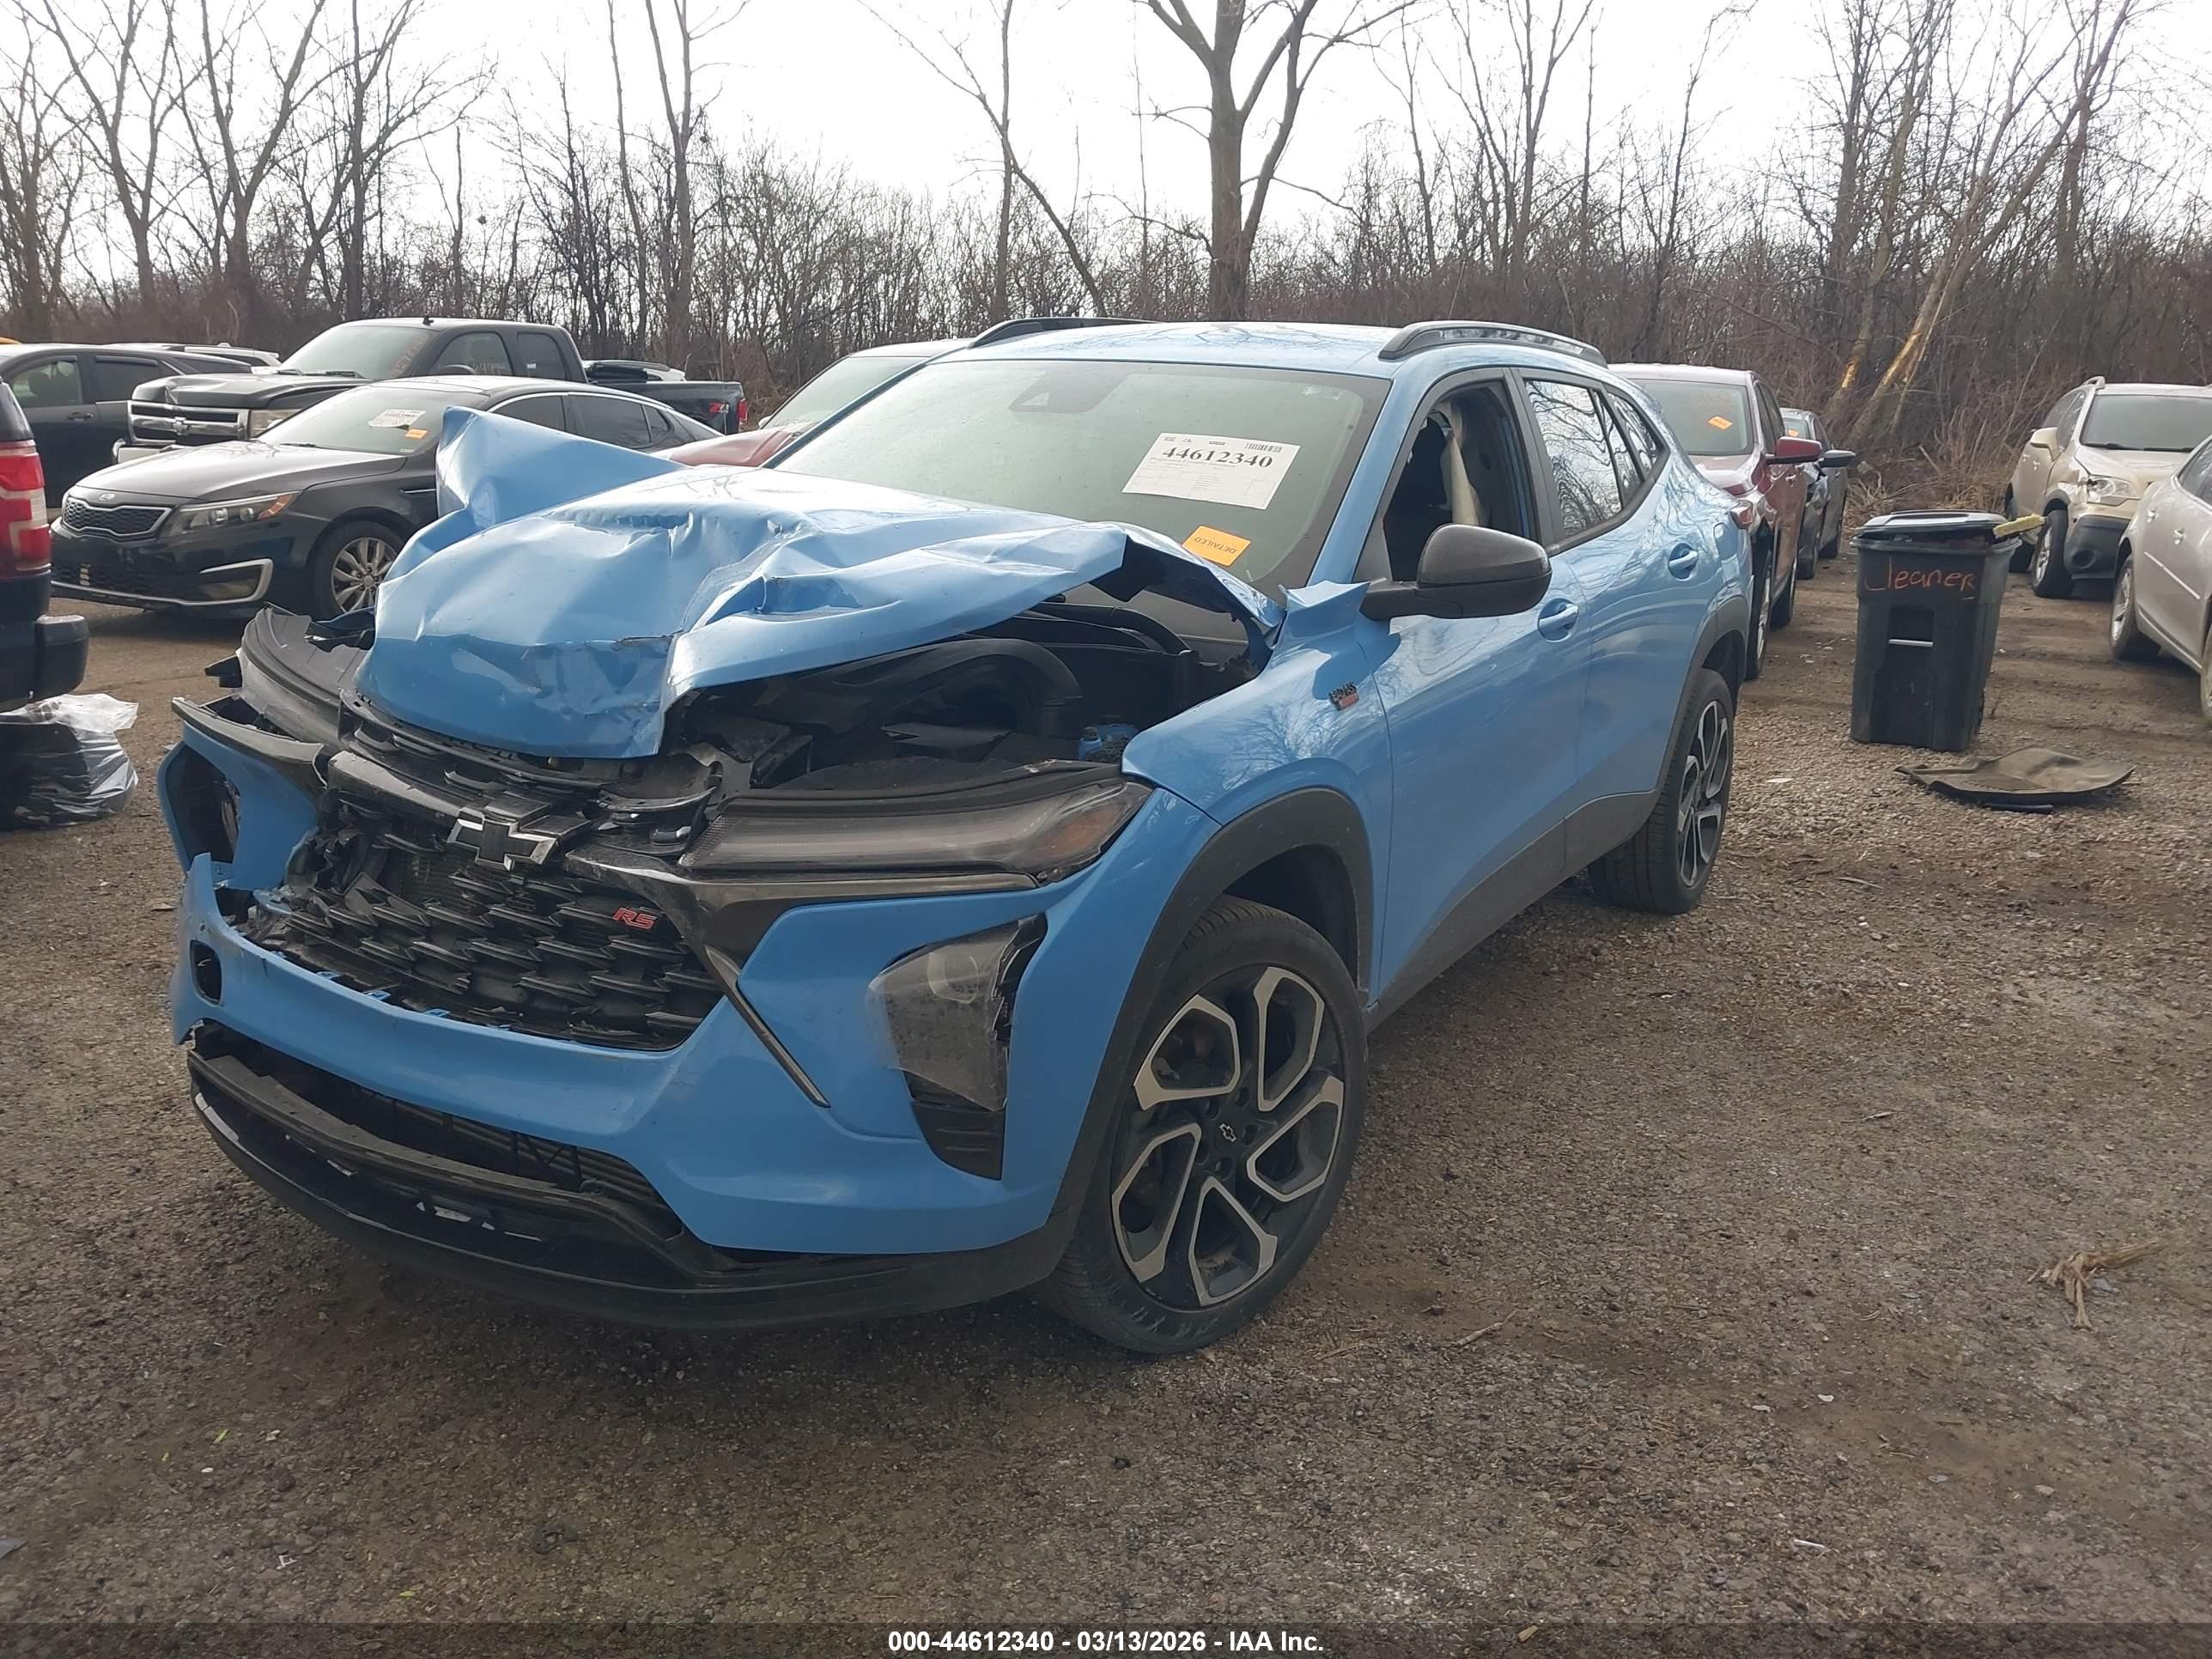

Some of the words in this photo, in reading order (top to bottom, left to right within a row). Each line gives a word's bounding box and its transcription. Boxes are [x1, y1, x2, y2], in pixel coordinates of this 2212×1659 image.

[1162, 447, 1273, 468] 44612340
[1194, 537, 1237, 554] DETAILED
[611, 907, 658, 929] RS
